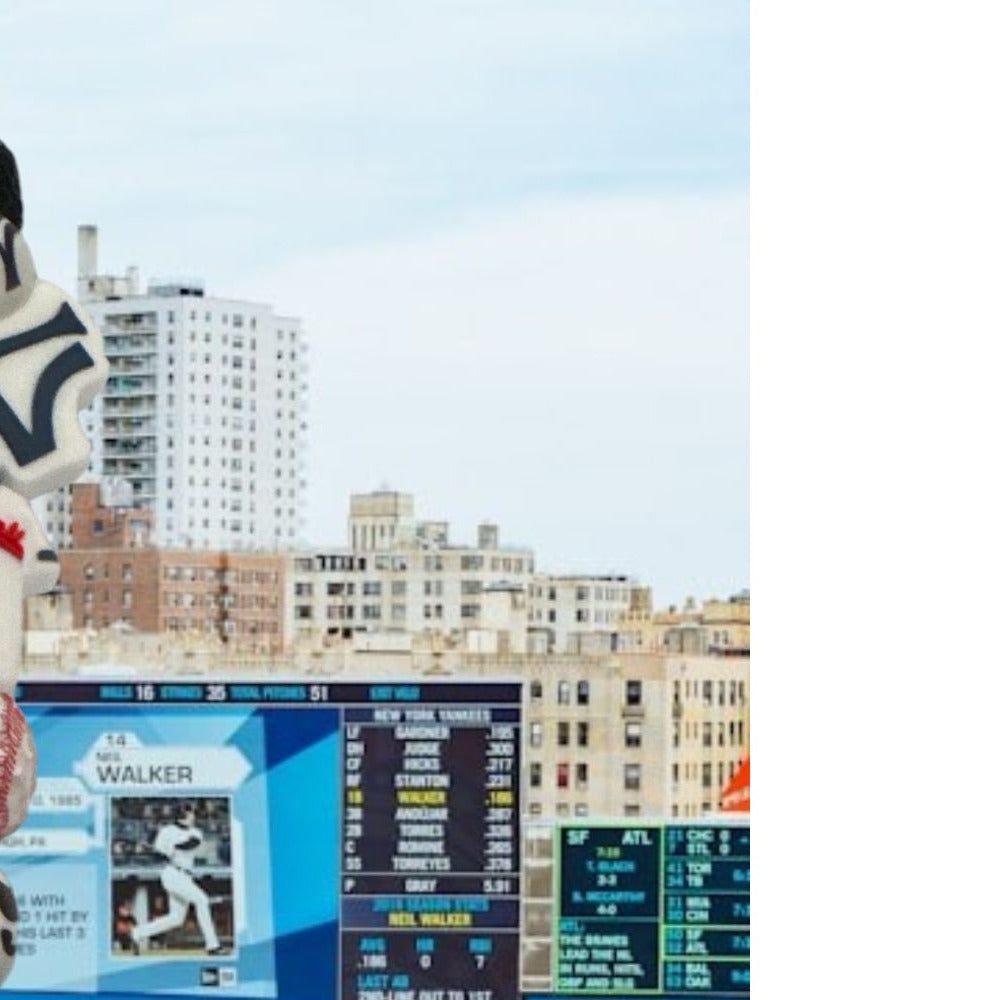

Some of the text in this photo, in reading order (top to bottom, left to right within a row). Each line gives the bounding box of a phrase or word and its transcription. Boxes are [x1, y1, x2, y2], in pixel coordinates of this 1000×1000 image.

[136, 685, 154, 700] 16
[96, 765, 194, 785] WALKER
[621, 830, 653, 845] ATL
